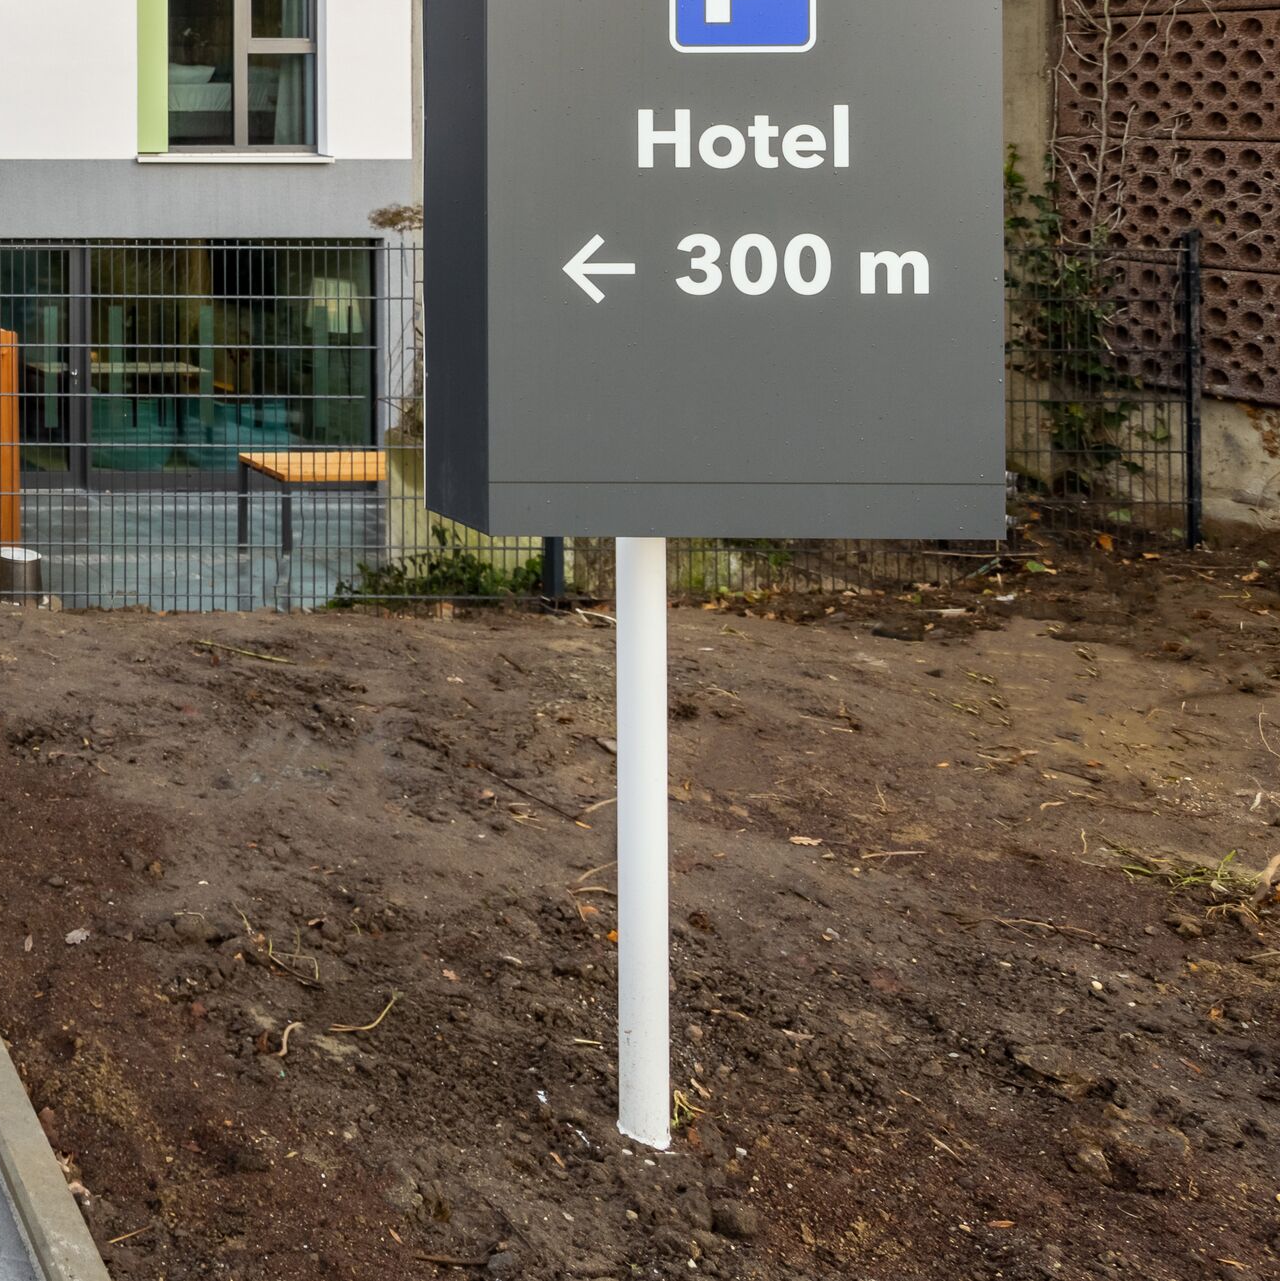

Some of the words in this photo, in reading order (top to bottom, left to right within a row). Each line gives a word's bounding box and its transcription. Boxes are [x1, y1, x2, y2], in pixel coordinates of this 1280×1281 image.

[637, 104, 850, 169] Hotel
[675, 233, 832, 296] 300
[859, 250, 930, 295] m
